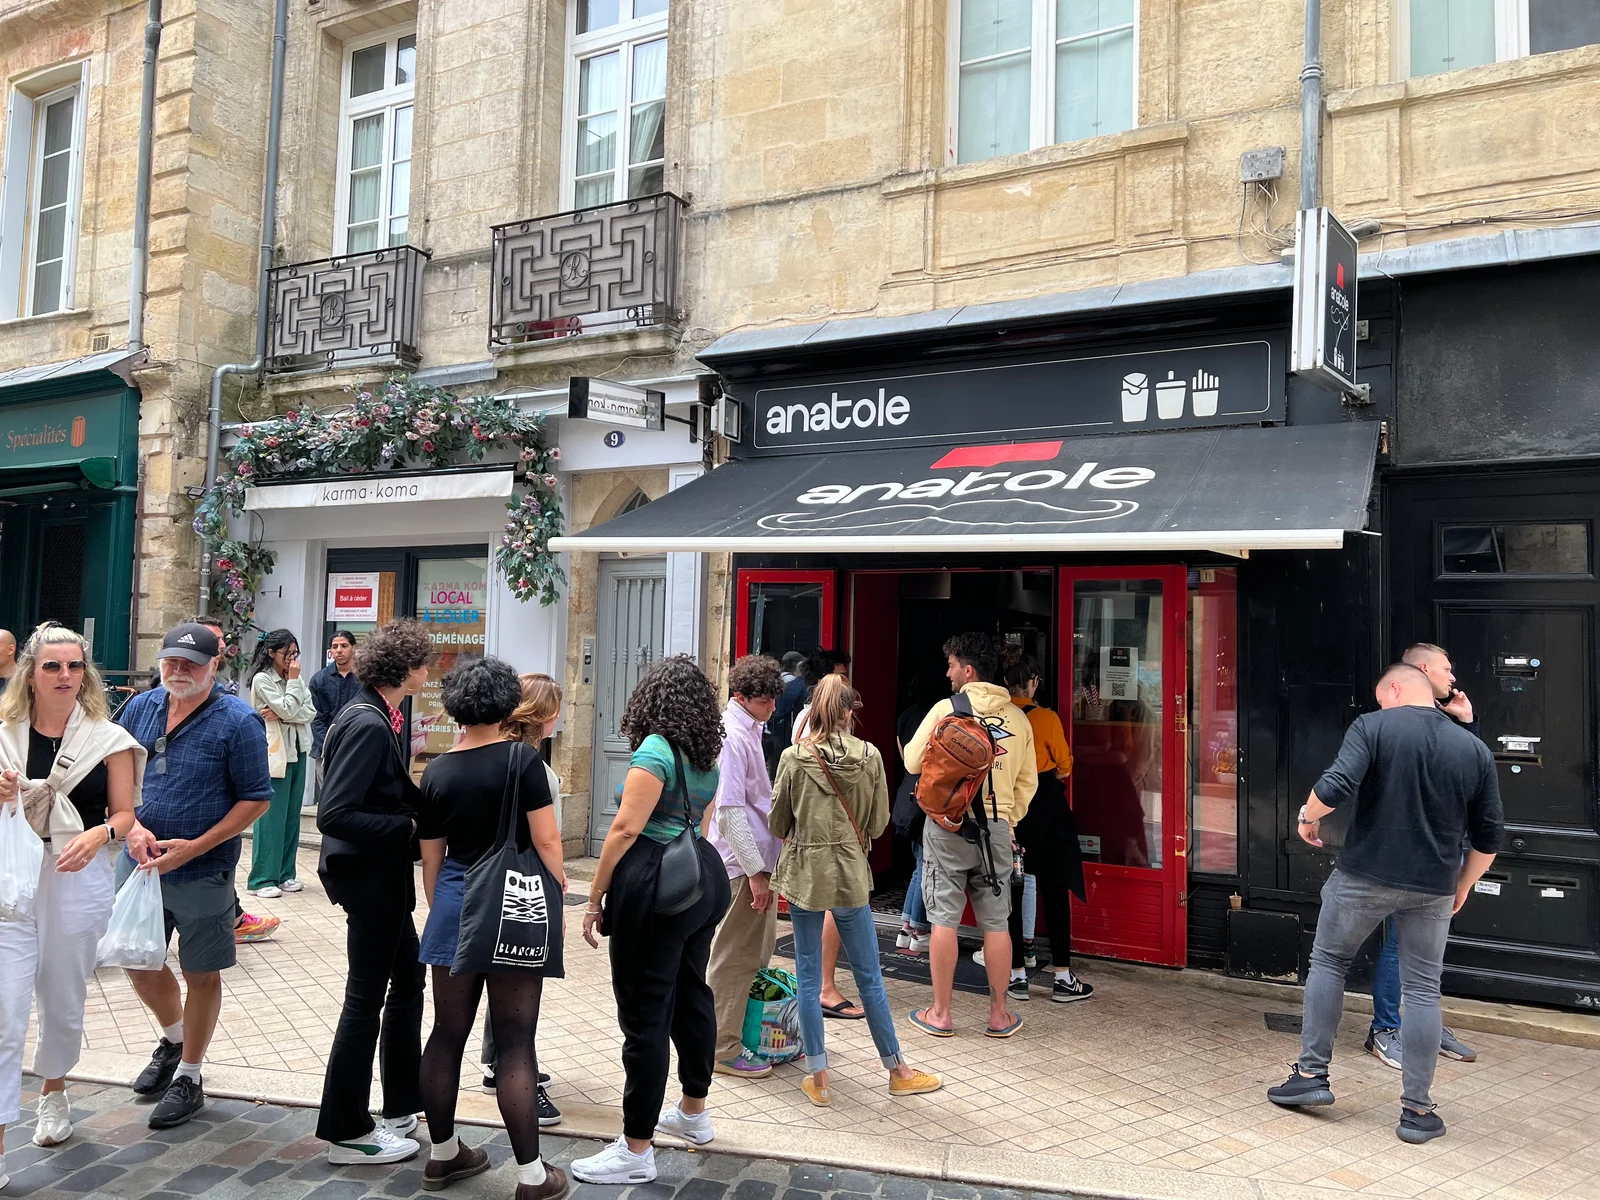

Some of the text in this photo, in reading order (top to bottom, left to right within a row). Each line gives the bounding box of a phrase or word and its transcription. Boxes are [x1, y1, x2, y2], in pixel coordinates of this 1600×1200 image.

[1331, 287, 1349, 312] anatole
[766, 388, 911, 435] anatole
[6, 422, 67, 453] Spécialités
[611, 433, 618, 446] 9
[797, 462, 1156, 504] anatole
[424, 582, 461, 591] KARMA
[354, 594, 367, 602] céder
[430, 591, 473, 604] LOCAL
[421, 606, 480, 624] À LOUER
[428, 632, 485, 645] DÉMÉNAGE
[418, 725, 451, 733] GALERIES
